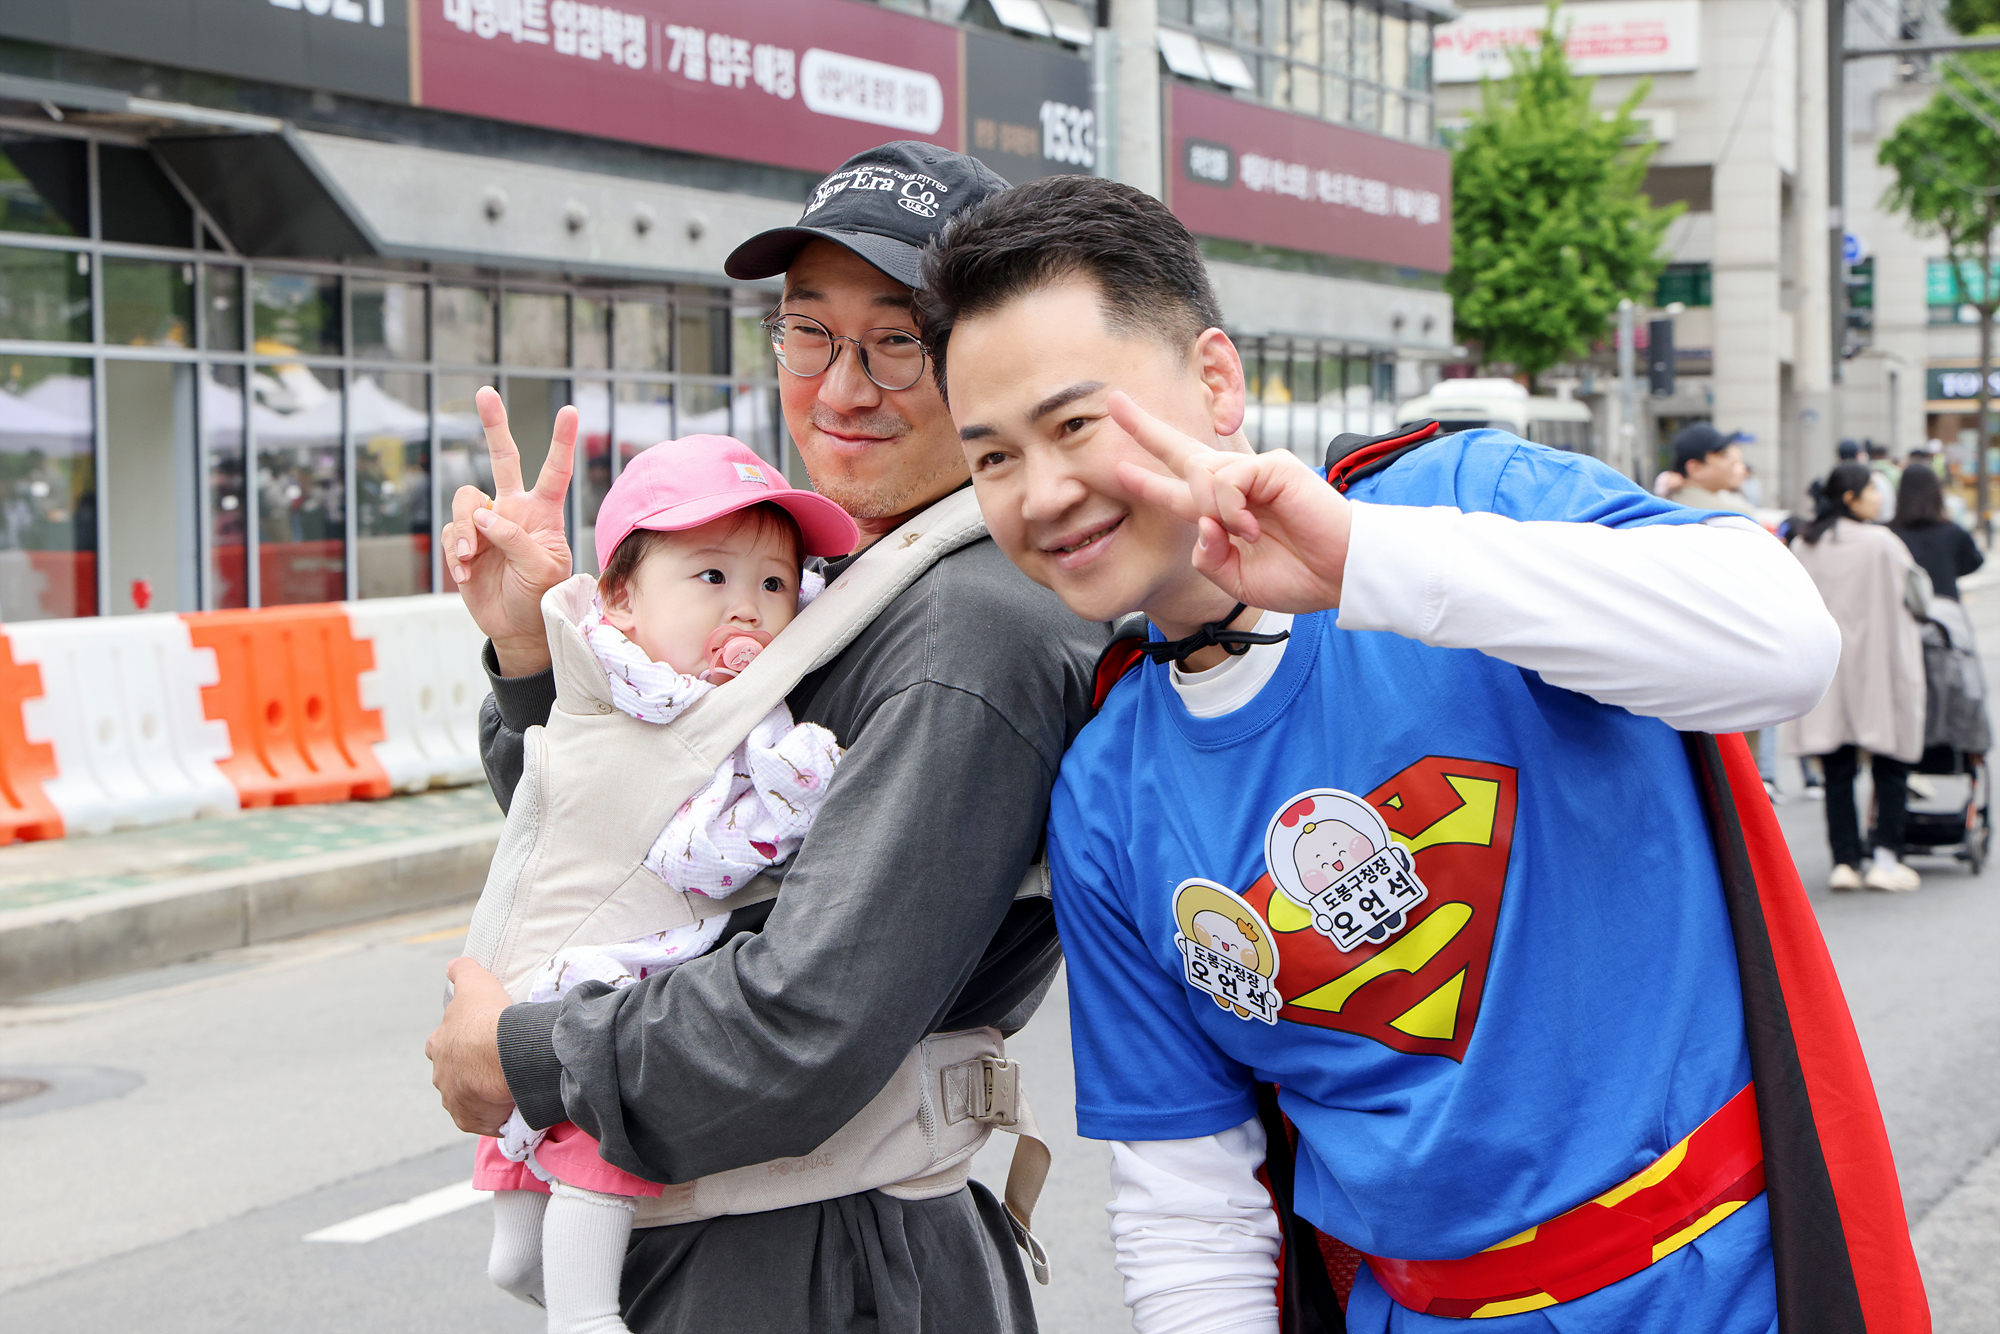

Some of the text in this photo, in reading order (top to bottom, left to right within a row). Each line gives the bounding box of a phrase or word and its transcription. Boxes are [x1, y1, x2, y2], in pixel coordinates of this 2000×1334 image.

[665, 23, 706, 82] 7월
[707, 32, 751, 90] 입주
[753, 43, 796, 100] 예정
[814, 172, 940, 210] New Era Co.
[894, 170, 917, 181] TRUE
[916, 174, 948, 193] FITTED
[1322, 856, 1391, 911] 도봉구청장
[1194, 946, 1259, 989] 도봉구청장
[767, 1153, 833, 1177] POGNAE
